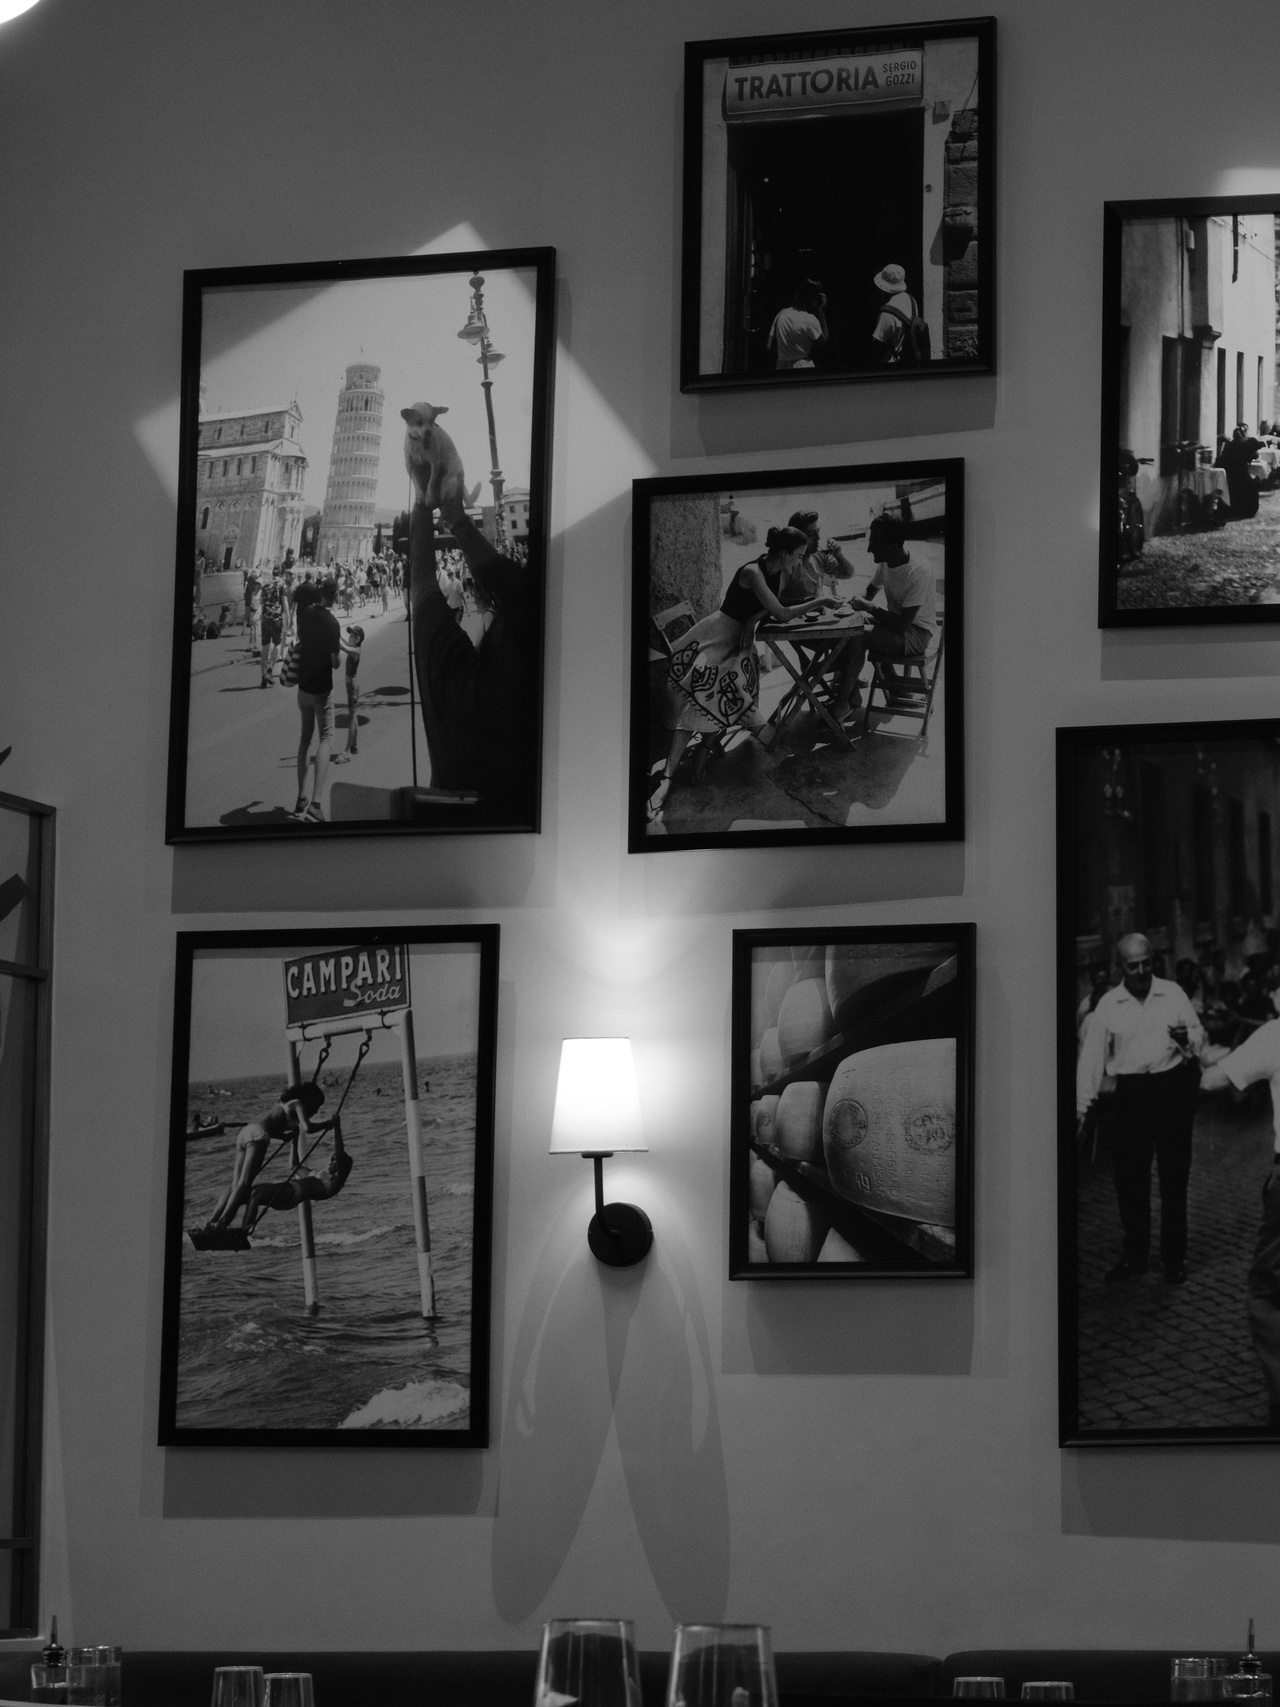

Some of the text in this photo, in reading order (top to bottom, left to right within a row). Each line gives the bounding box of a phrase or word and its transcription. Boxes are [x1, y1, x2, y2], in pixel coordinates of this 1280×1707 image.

[882, 60, 917, 73] SERGIO
[885, 73, 915, 87] GOZZI
[734, 65, 880, 102] TRATTORIA
[287, 946, 402, 999] CAMPARI
[342, 976, 402, 1007] Soda
